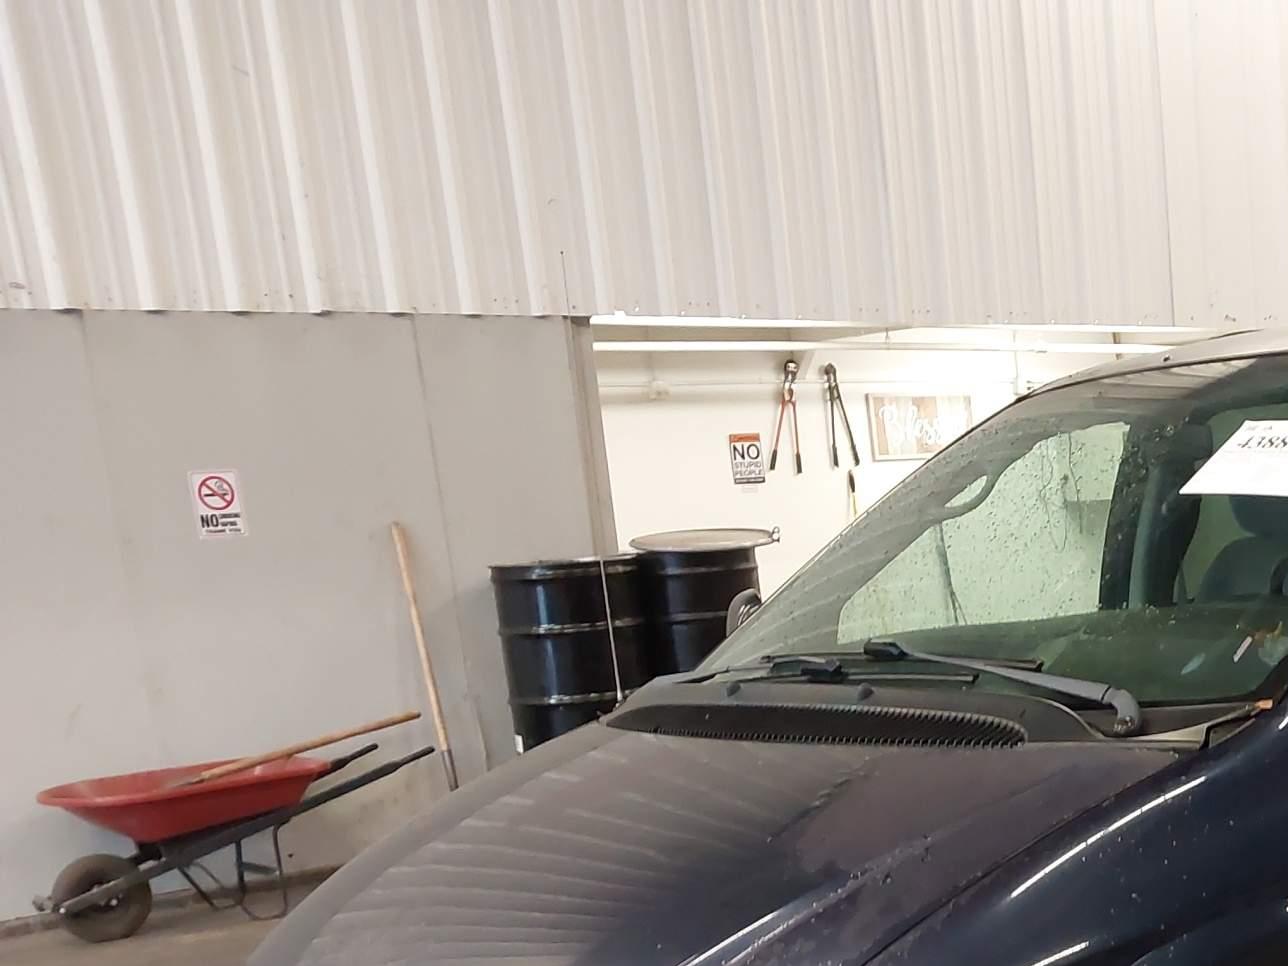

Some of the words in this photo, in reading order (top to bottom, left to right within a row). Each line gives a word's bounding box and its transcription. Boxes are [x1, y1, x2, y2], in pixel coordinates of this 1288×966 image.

[732, 443, 760, 461] NO
[734, 460, 762, 470] STUPID
[734, 469, 763, 477] PEOPLE
[200, 513, 219, 528] NO
